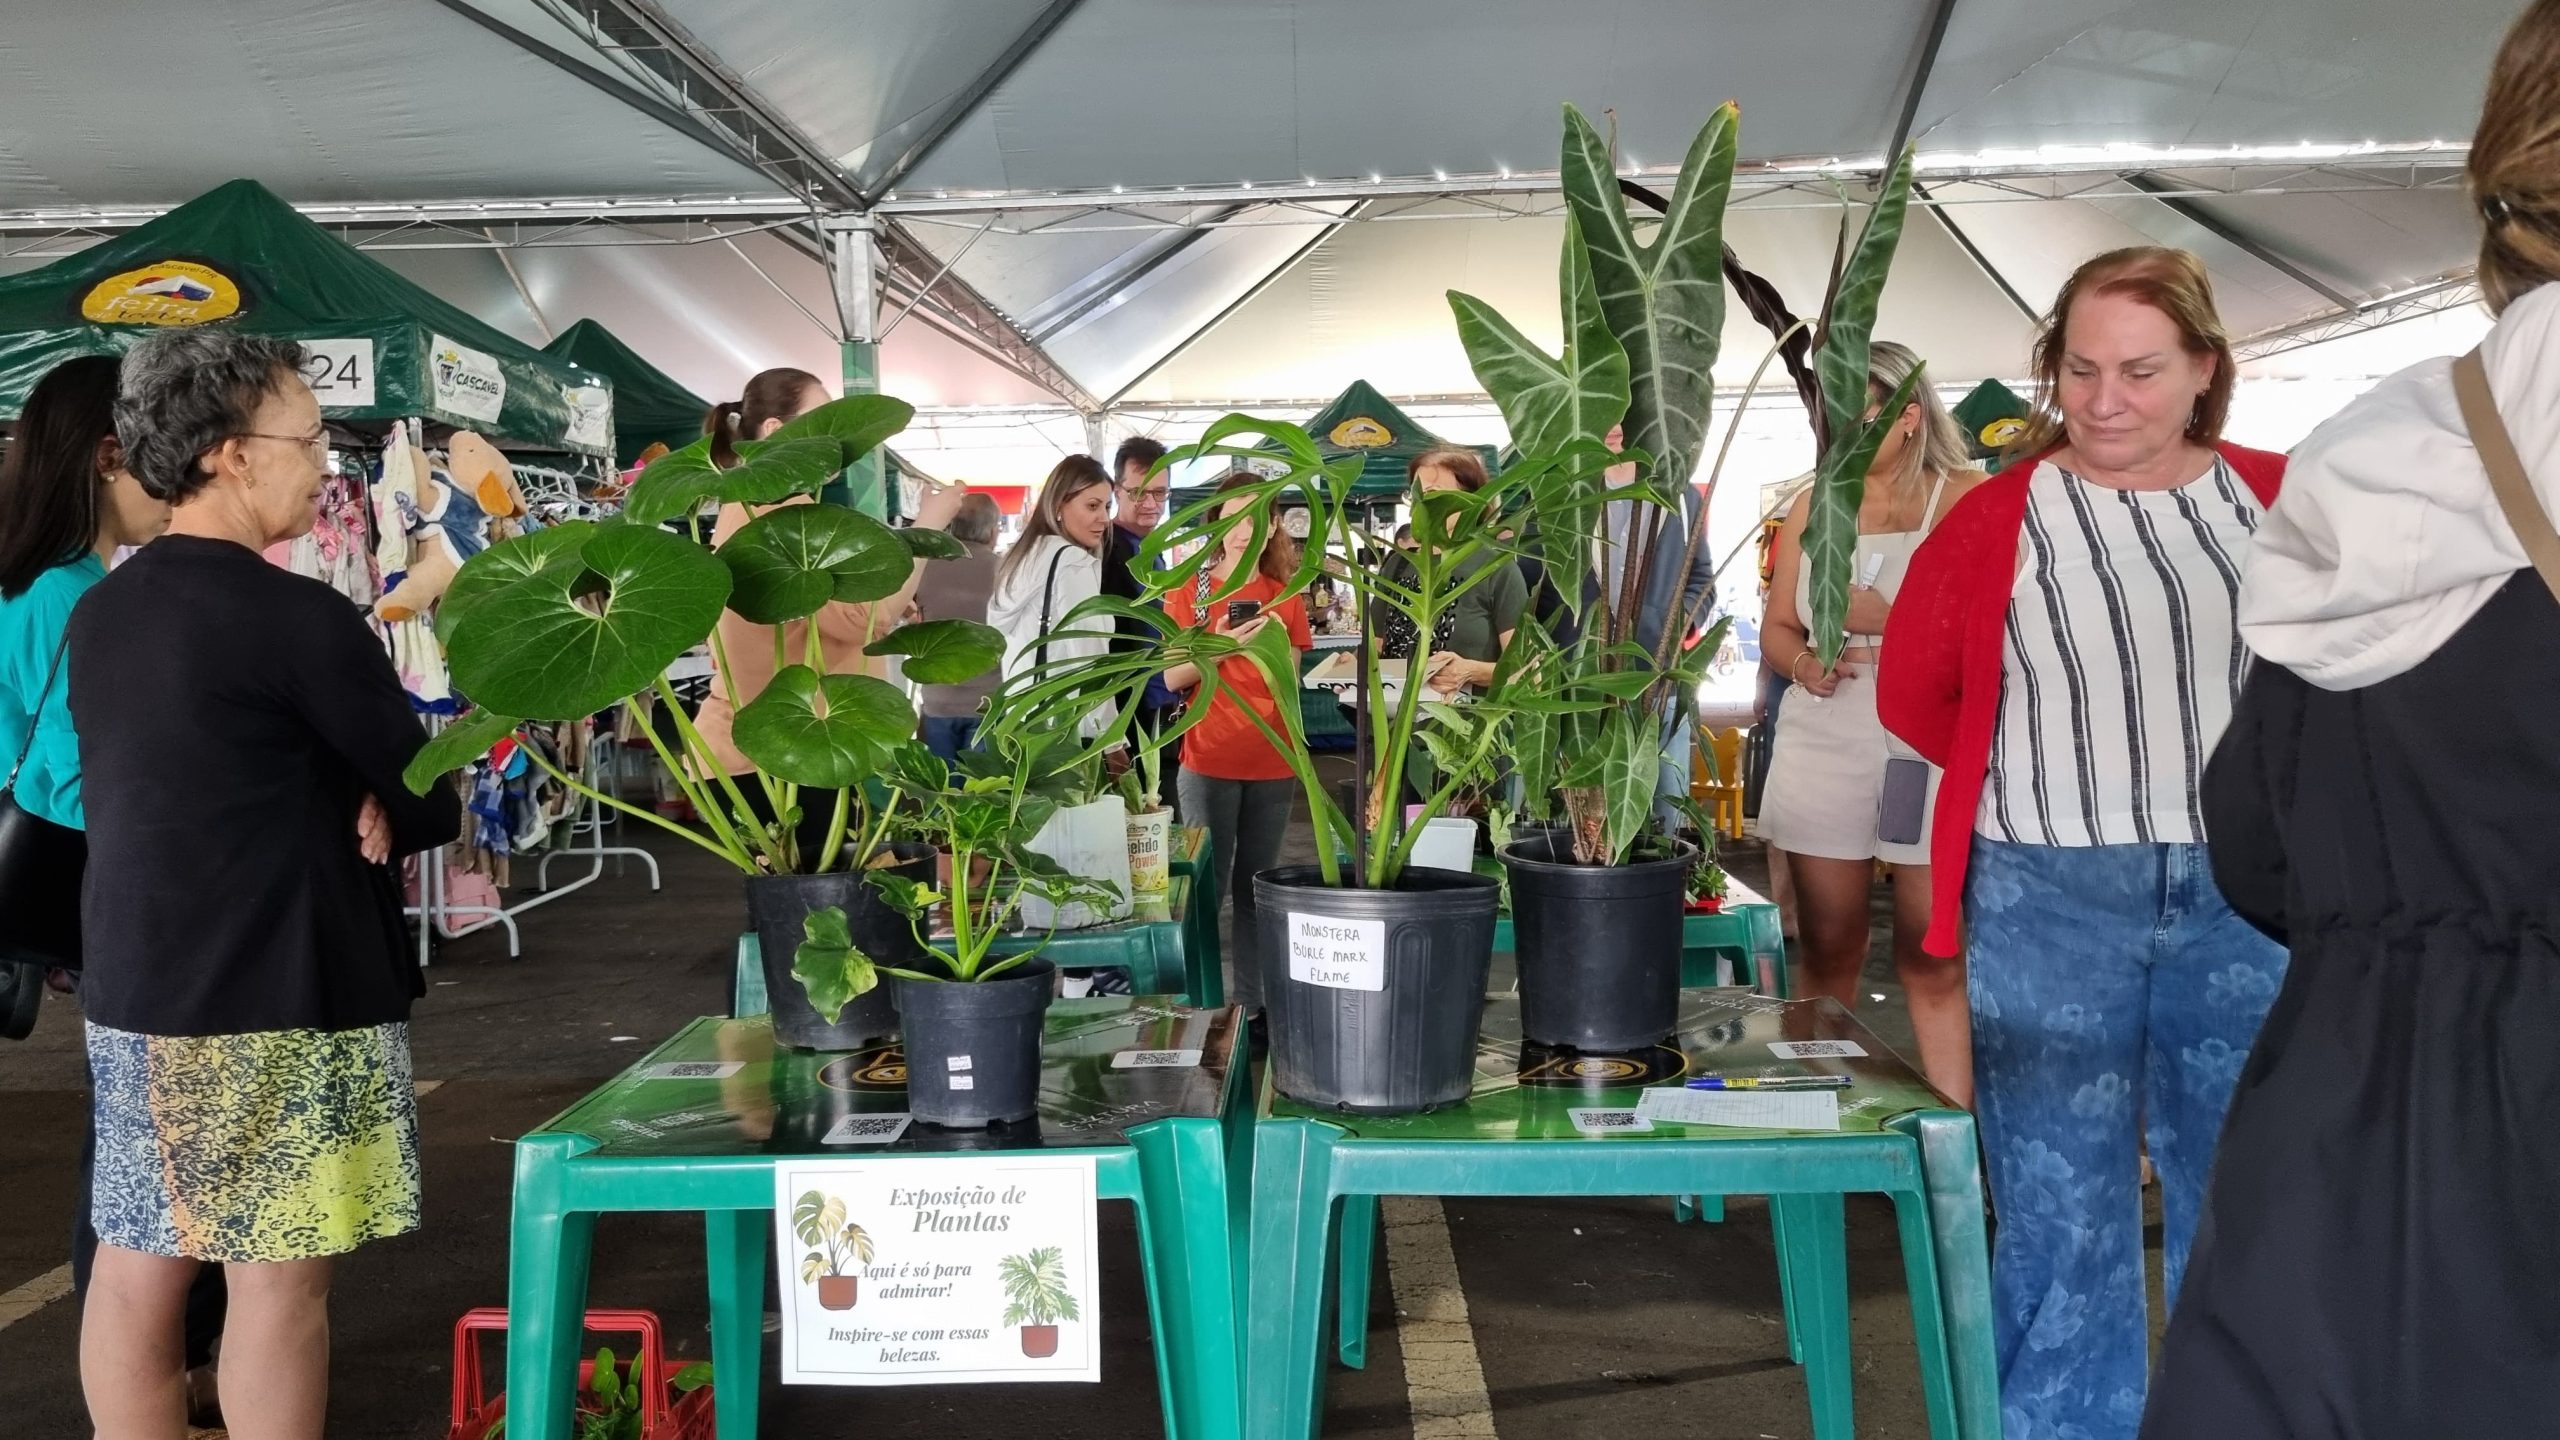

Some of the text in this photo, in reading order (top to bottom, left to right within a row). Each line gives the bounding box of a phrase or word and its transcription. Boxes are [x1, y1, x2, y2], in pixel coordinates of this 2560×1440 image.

[310, 354, 362, 390] 24
[456, 373, 499, 396] CASCAVEL
[1301, 922, 1361, 941] MONSTERA
[1293, 941, 1325, 960] BURLE
[1310, 967, 1350, 983] FLAME
[889, 1185, 1027, 1210] Exposição de
[912, 1209, 1011, 1233] Plantas
[857, 1261, 972, 1281] Aqui é só para
[879, 1283, 953, 1300] admirar!
[828, 1327, 990, 1345] Inspire-se com essas
[879, 1347, 941, 1363] belezas.
